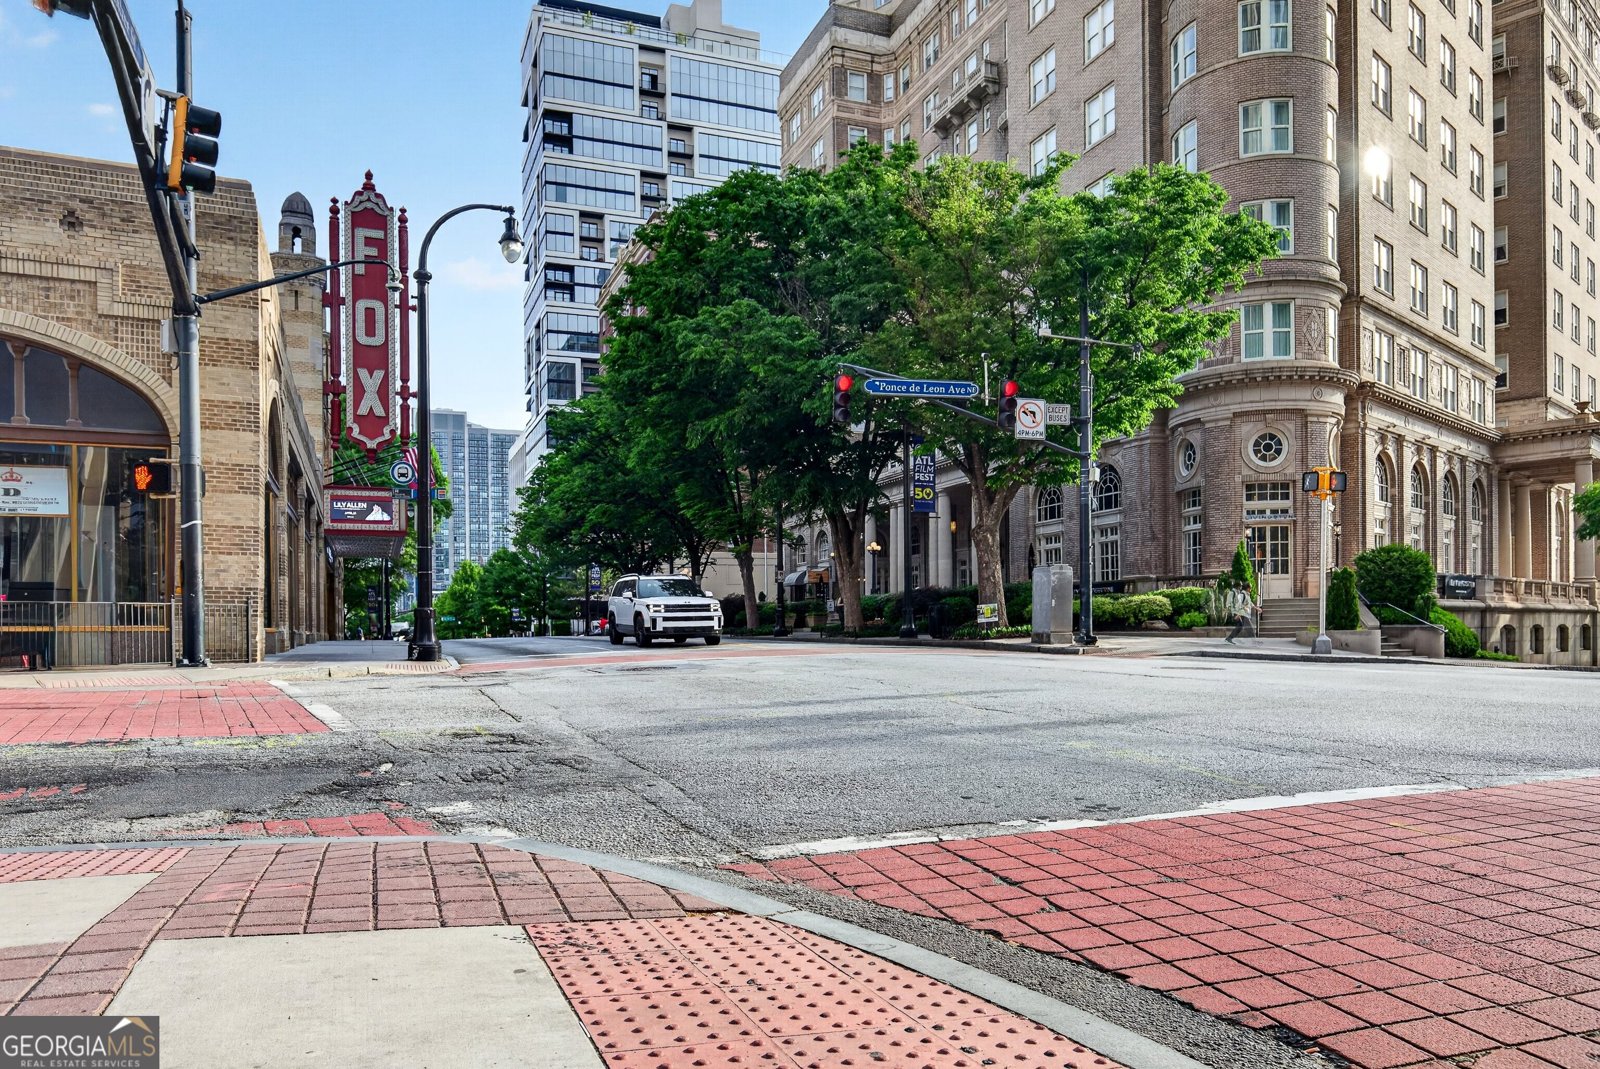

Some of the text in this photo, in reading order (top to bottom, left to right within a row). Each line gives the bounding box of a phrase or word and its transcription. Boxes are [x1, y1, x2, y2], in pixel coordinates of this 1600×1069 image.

[354, 227, 386, 417] FOX
[880, 382, 907, 392] Ponce
[909, 383, 921, 392] de
[923, 384, 945, 393] Leon
[948, 385, 966, 394] Ave
[1047, 406, 1068, 414] EXCEPT
[1048, 414, 1067, 422] BUSES
[915, 455, 934, 465] ATL
[915, 465, 934, 473] FILM
[915, 473, 934, 481] FEST
[915, 487, 934, 499] 50
